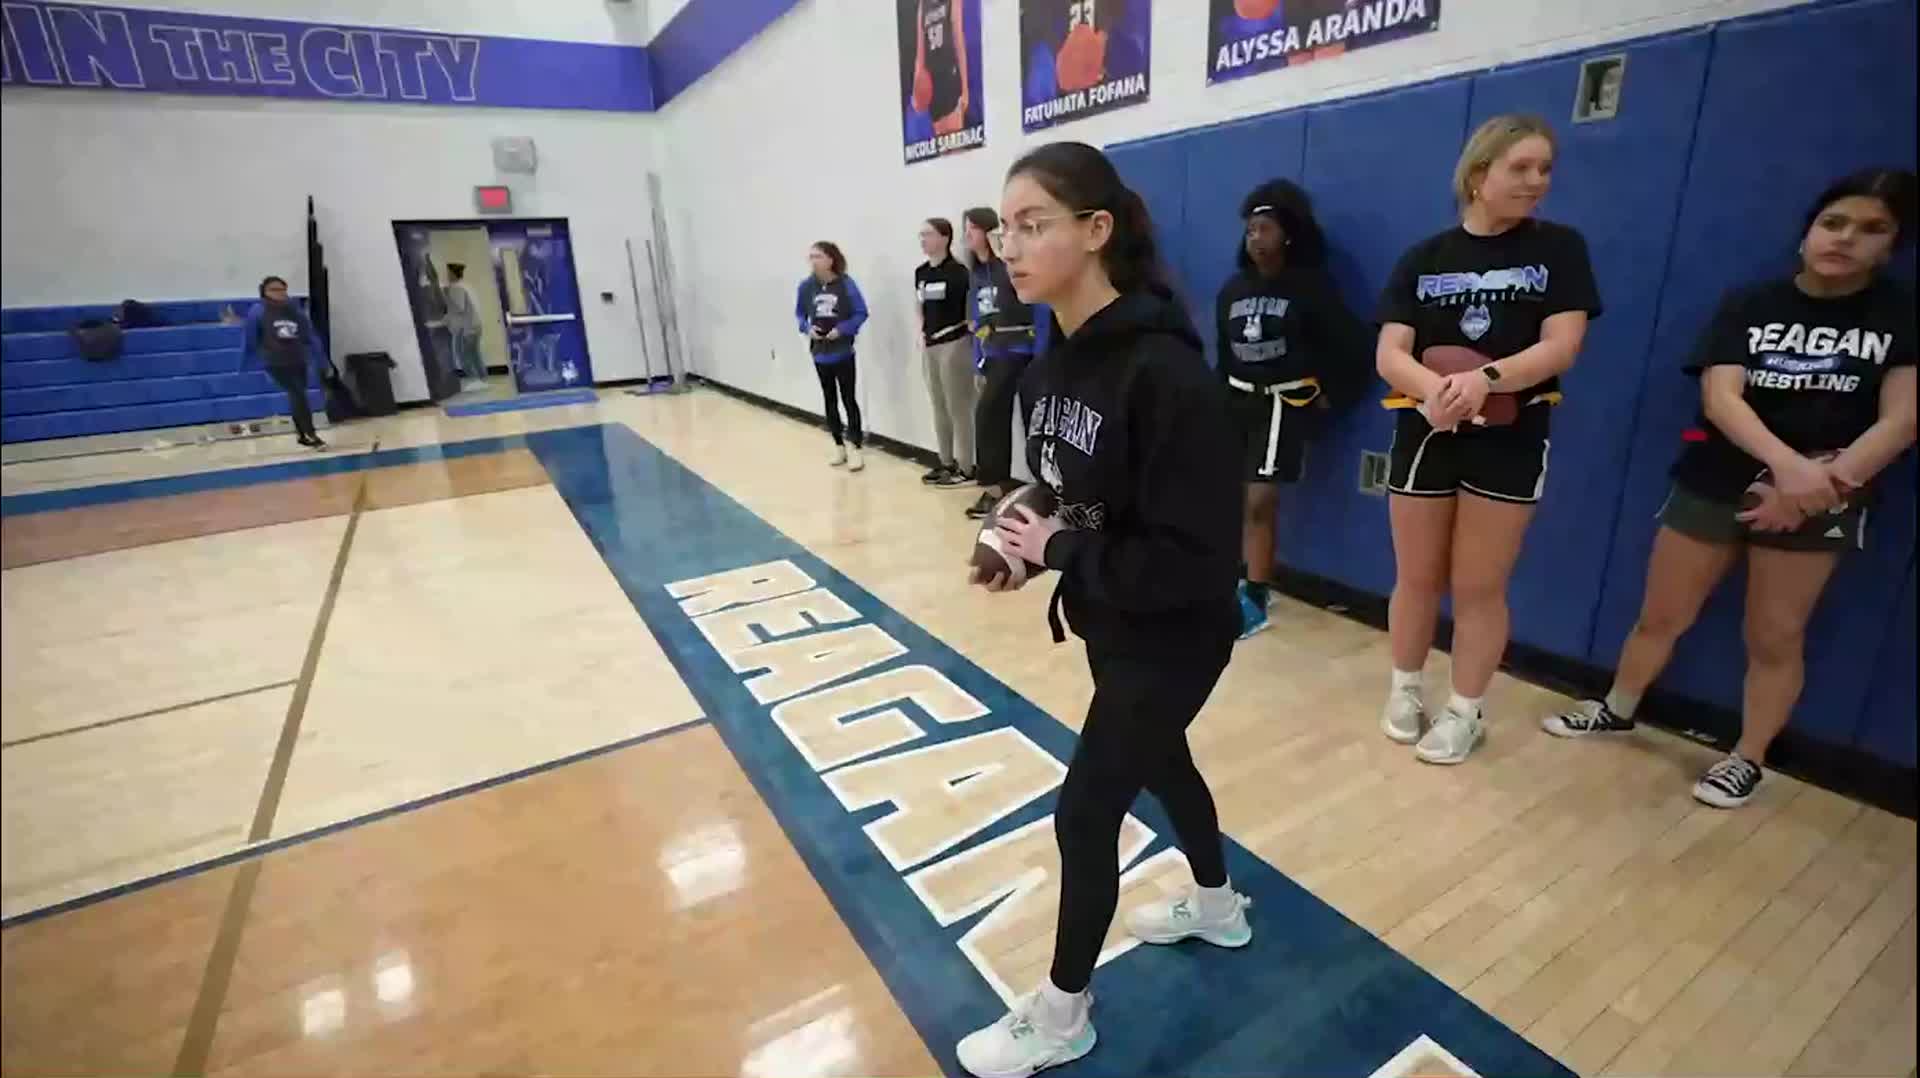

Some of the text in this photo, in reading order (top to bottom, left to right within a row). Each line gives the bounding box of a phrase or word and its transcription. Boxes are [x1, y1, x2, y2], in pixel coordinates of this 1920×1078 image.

[148, 24, 295, 85] THE
[300, 27, 480, 101] CITY
[1216, 0, 1427, 71] ALYSSA ARANDA
[1024, 73, 1146, 124] FATUMATA FOFANA
[905, 137, 937, 160] NICOLE
[1747, 322, 1893, 365] REAGAN
[662, 558, 1198, 1018] REAGAN
